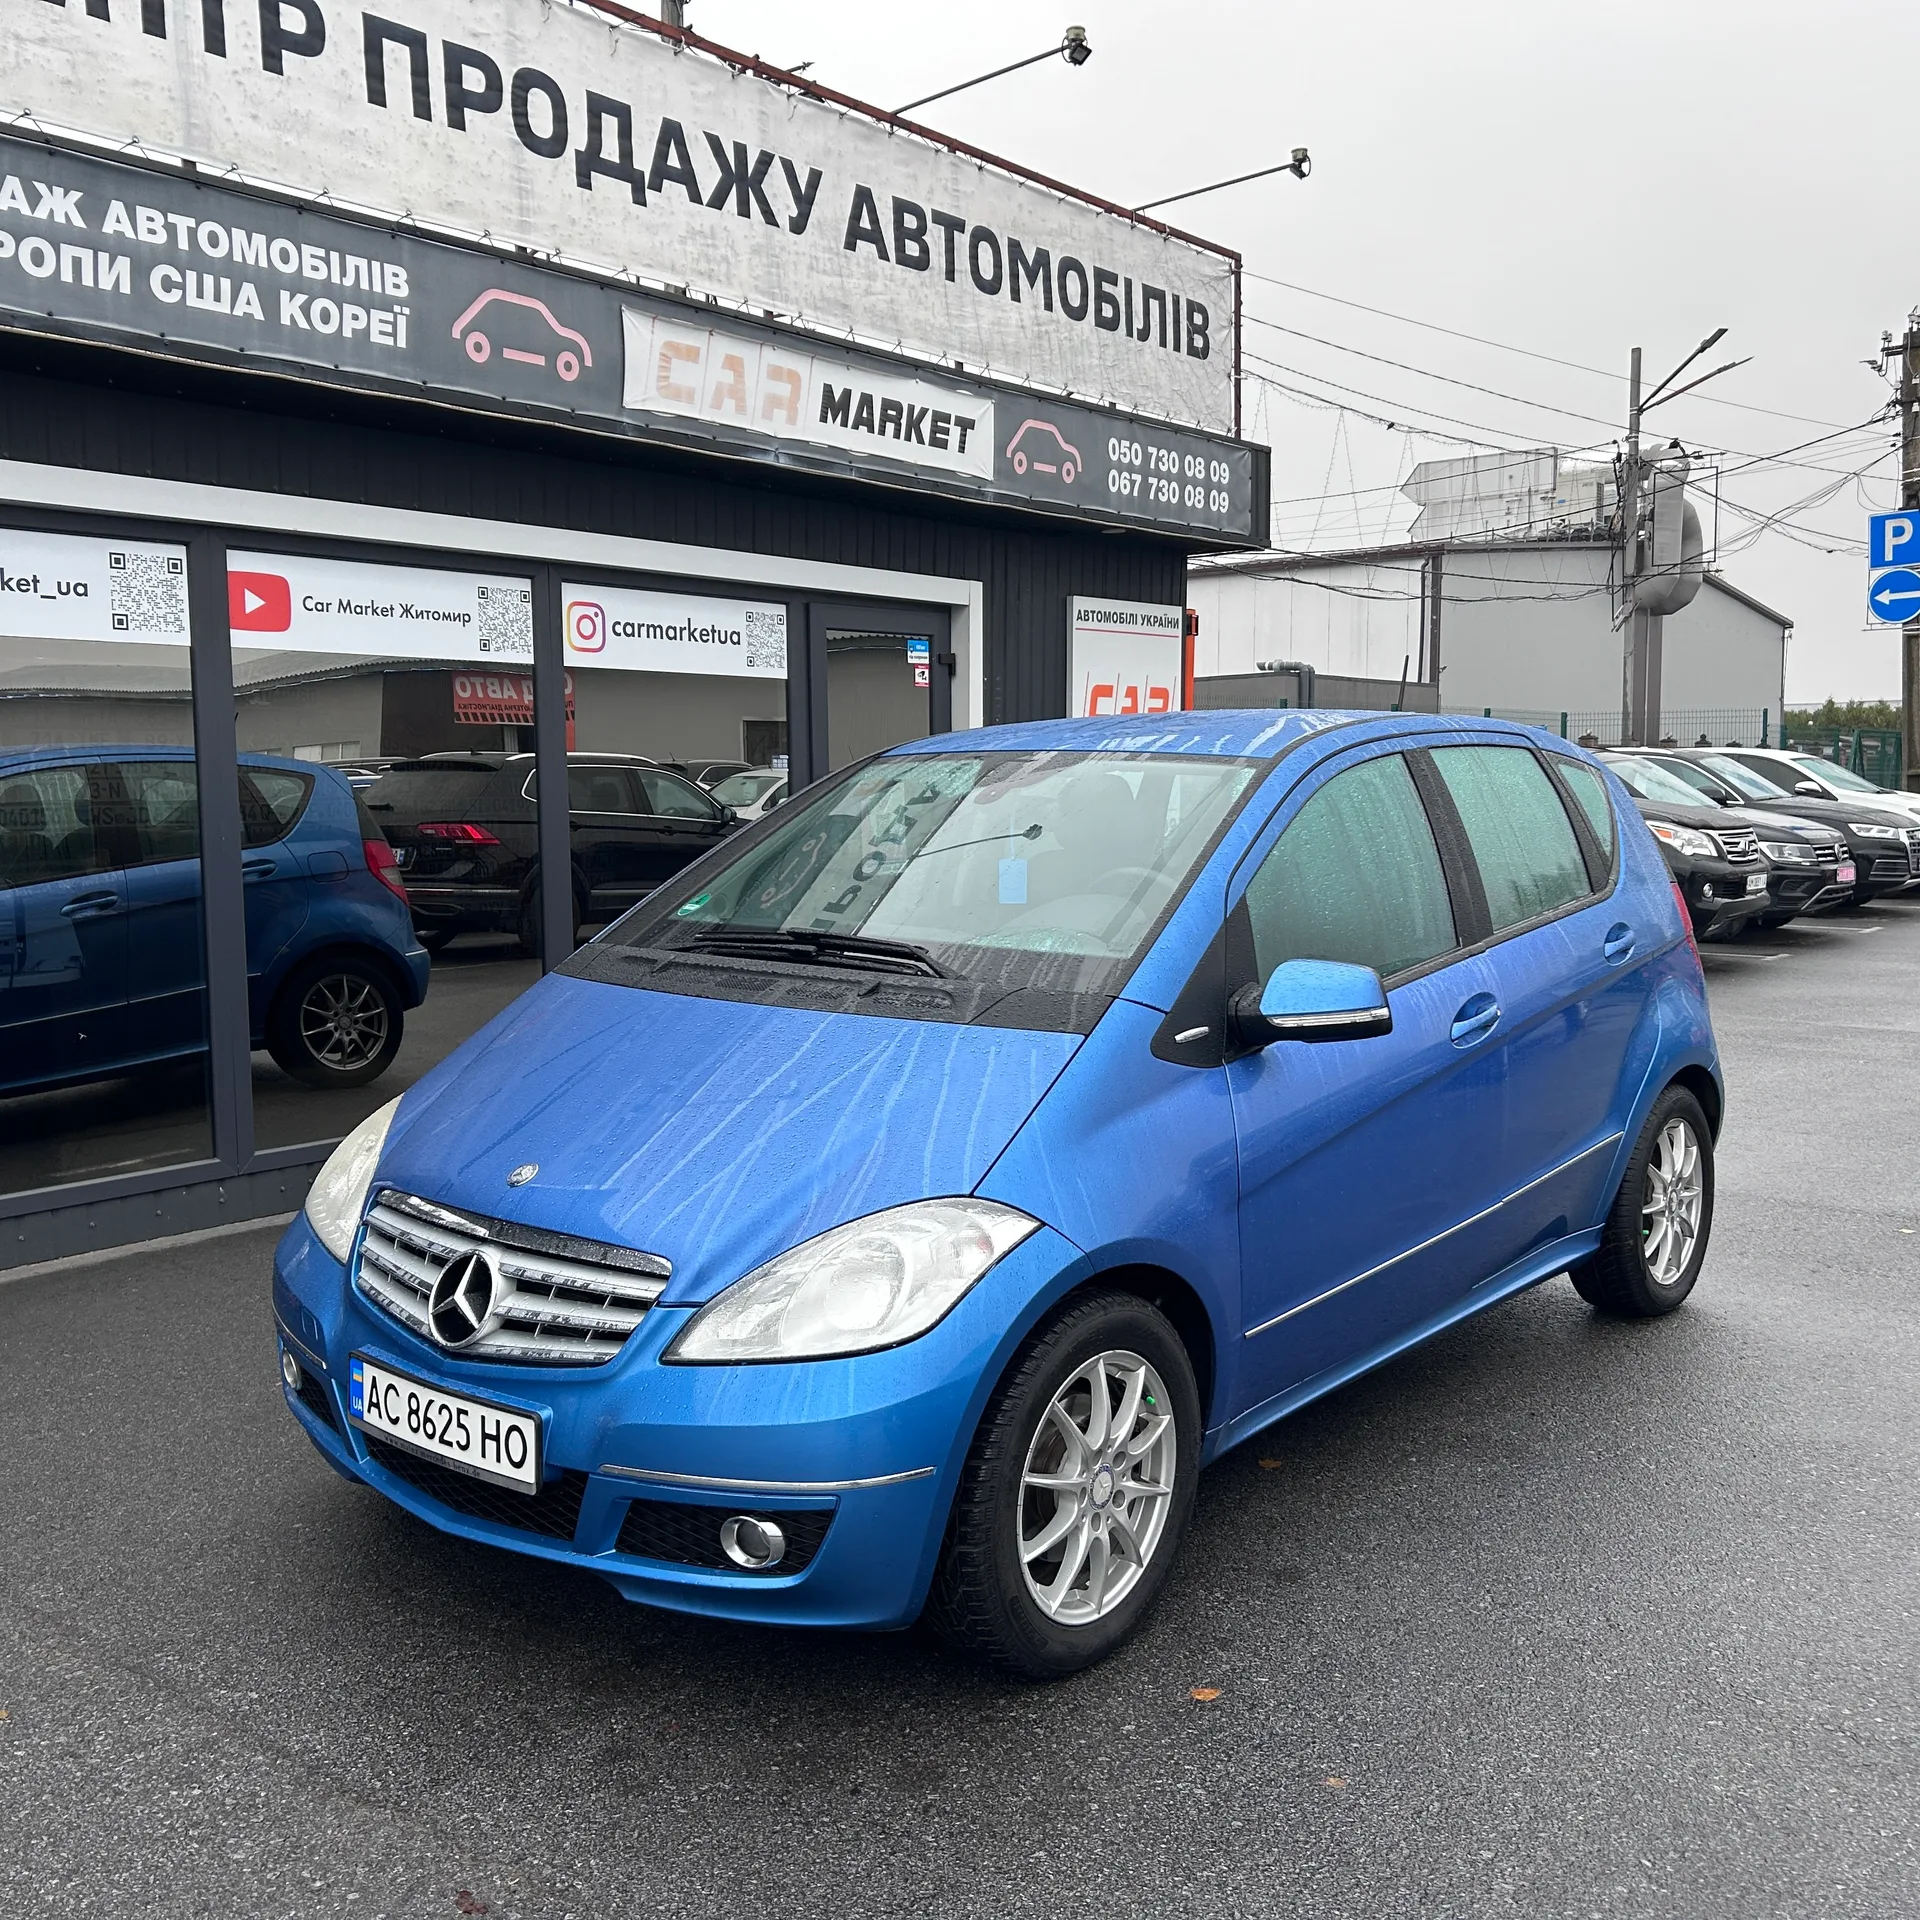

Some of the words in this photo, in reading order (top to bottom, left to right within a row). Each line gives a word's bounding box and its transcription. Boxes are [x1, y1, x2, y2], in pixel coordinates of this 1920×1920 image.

[361, 11, 823, 235] ПРОДАЖУ
[844, 184, 1210, 361] АВТОМОБІЛІВ
[102, 199, 410, 298] АВТОМОБІЛІВ
[149, 263, 265, 321] США
[279, 288, 411, 348] КОРЕЇ
[656, 340, 802, 427] CAR
[818, 382, 977, 454] MARKET
[1108, 437, 1142, 466] 050
[1147, 445, 1179, 474] 730
[1184, 454, 1205, 479] 08
[1210, 460, 1230, 484] 09
[1108, 469, 1142, 497] 067
[1148, 476, 1179, 504] 730
[1184, 484, 1205, 509] 08
[1209, 489, 1229, 513] 09
[1884, 518, 1913, 561] P
[302, 595, 332, 613] Car
[337, 598, 395, 618] Market
[398, 602, 472, 627] Житомир
[611, 617, 741, 645] carmarketua
[1076, 608, 1138, 626] АВТОМОБІЛІ
[1140, 613, 1180, 629] УКРАЇНИ
[352, 1395, 363, 1412] UA
[367, 1375, 400, 1425] AC
[407, 1392, 471, 1451] 8625
[480, 1414, 528, 1469] HO
